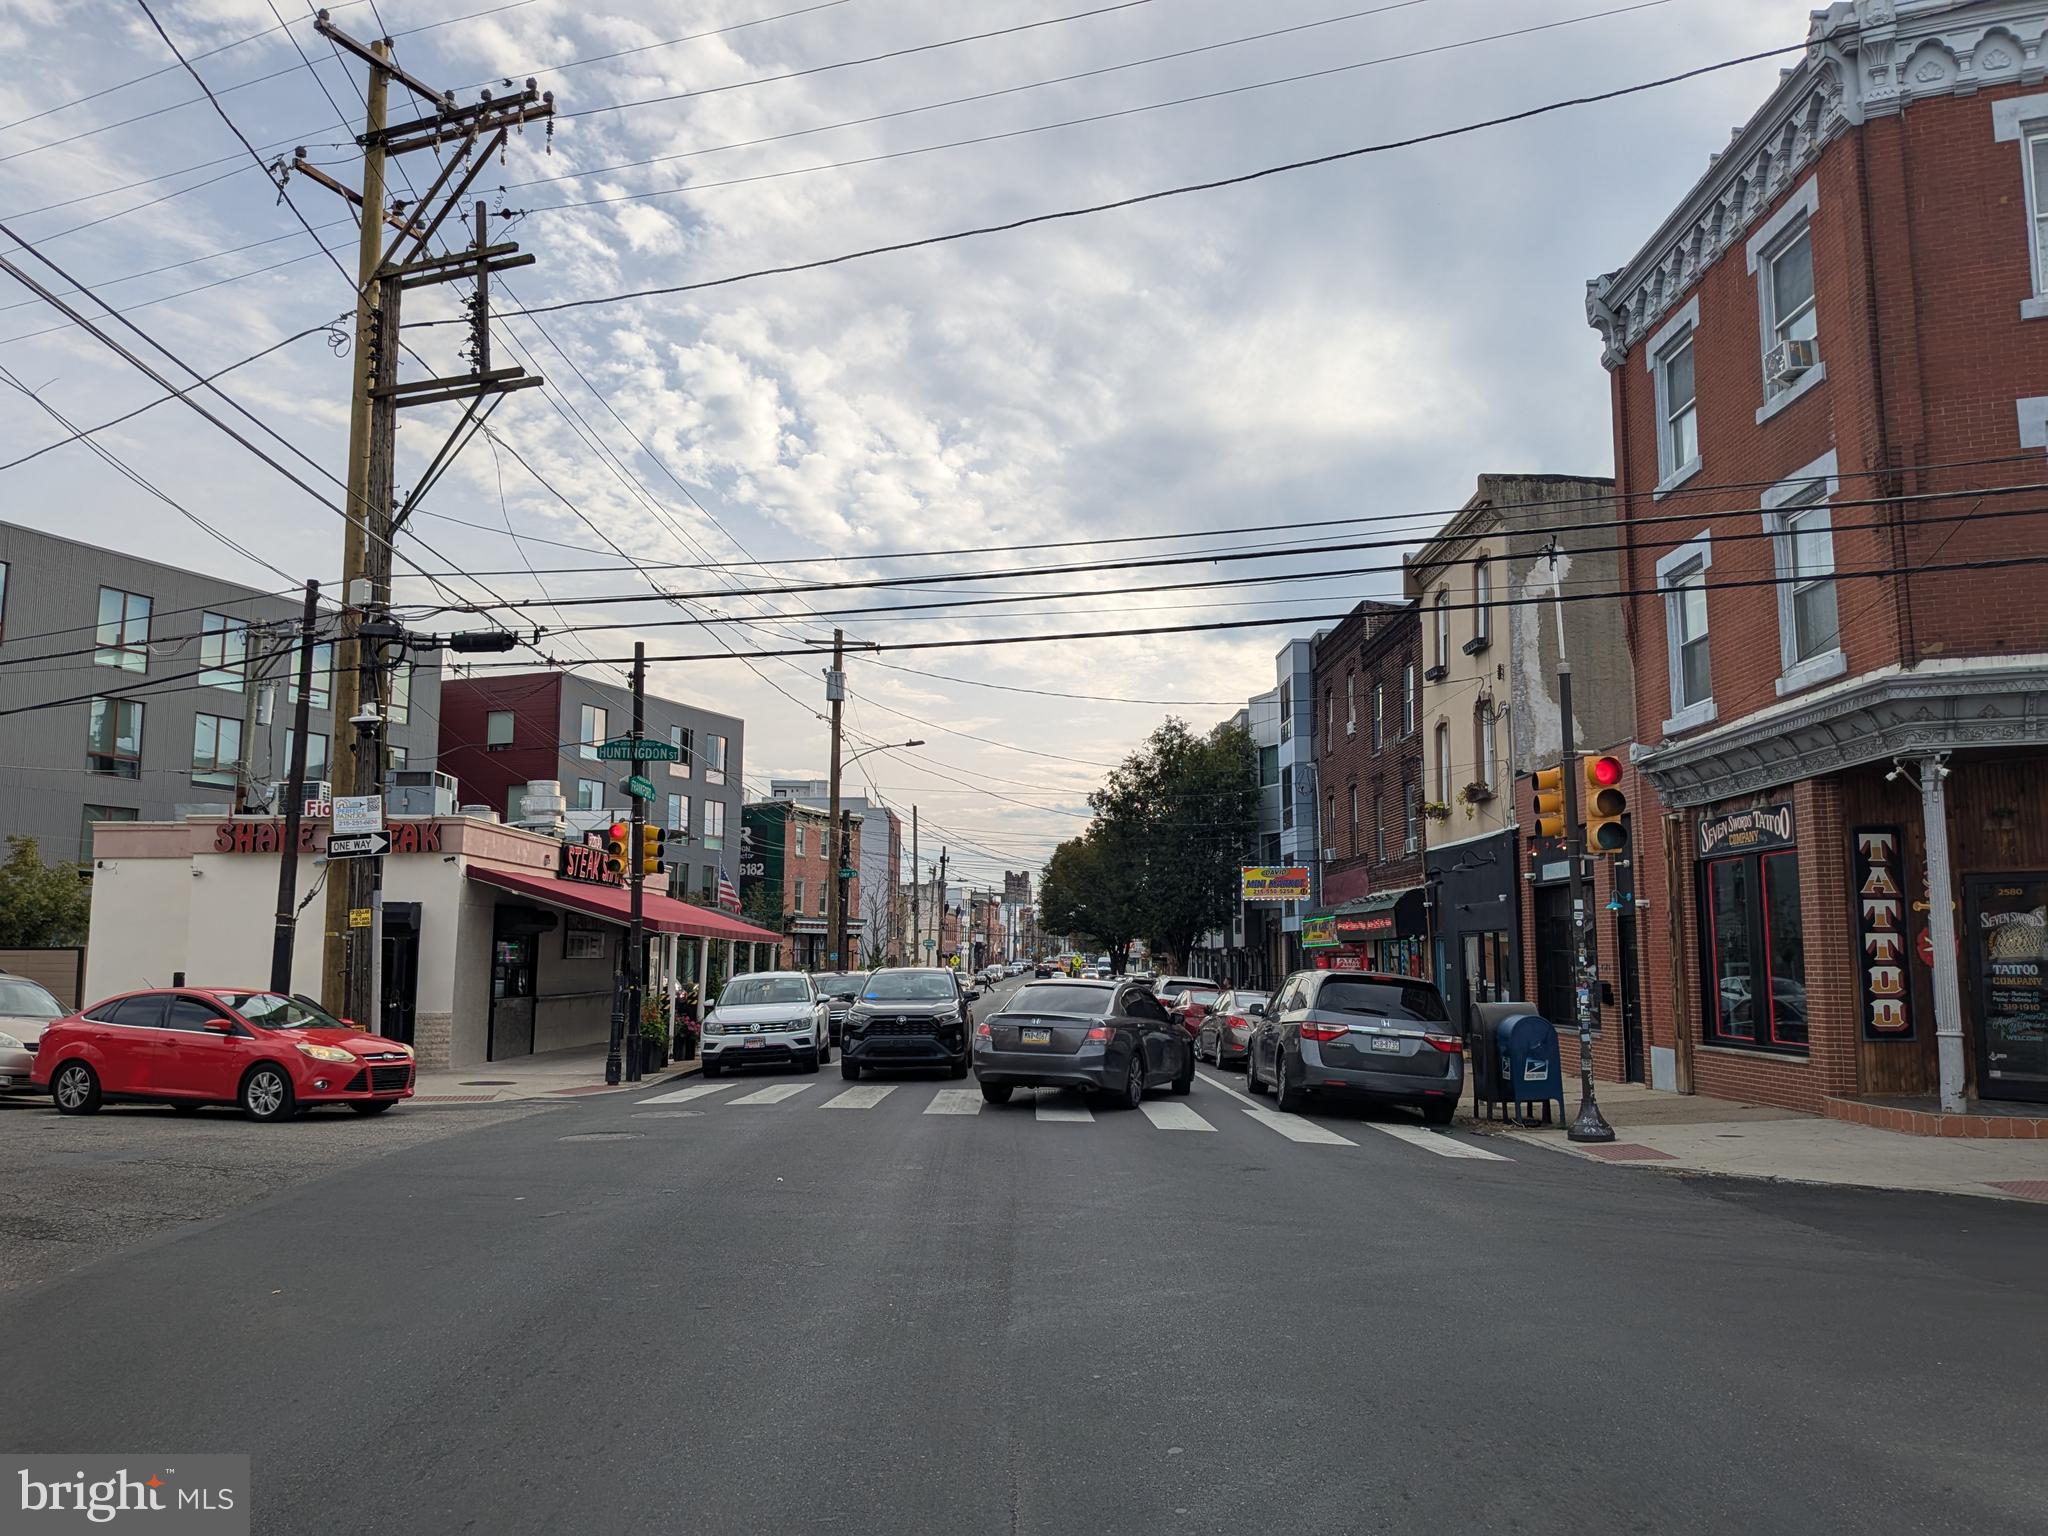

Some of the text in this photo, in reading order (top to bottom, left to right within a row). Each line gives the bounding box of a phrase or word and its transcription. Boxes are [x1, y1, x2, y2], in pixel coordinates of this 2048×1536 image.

[598, 746, 678, 760] HUNTINGDON ST
[1701, 806, 1790, 853] SEVEN SWORDS TATTOO
[333, 839, 371, 851] ONE WAY
[1728, 830, 1759, 846] COMPANY
[566, 845, 601, 881] STEAK
[1264, 869, 1287, 877] DAVID
[1998, 888, 2023, 896] 2580
[1980, 912, 2009, 928] SEVEN
[1858, 833, 1907, 1029] TATTOO
[1992, 964, 2039, 975] TATTOO
[1992, 976, 2043, 986] COMPANY
